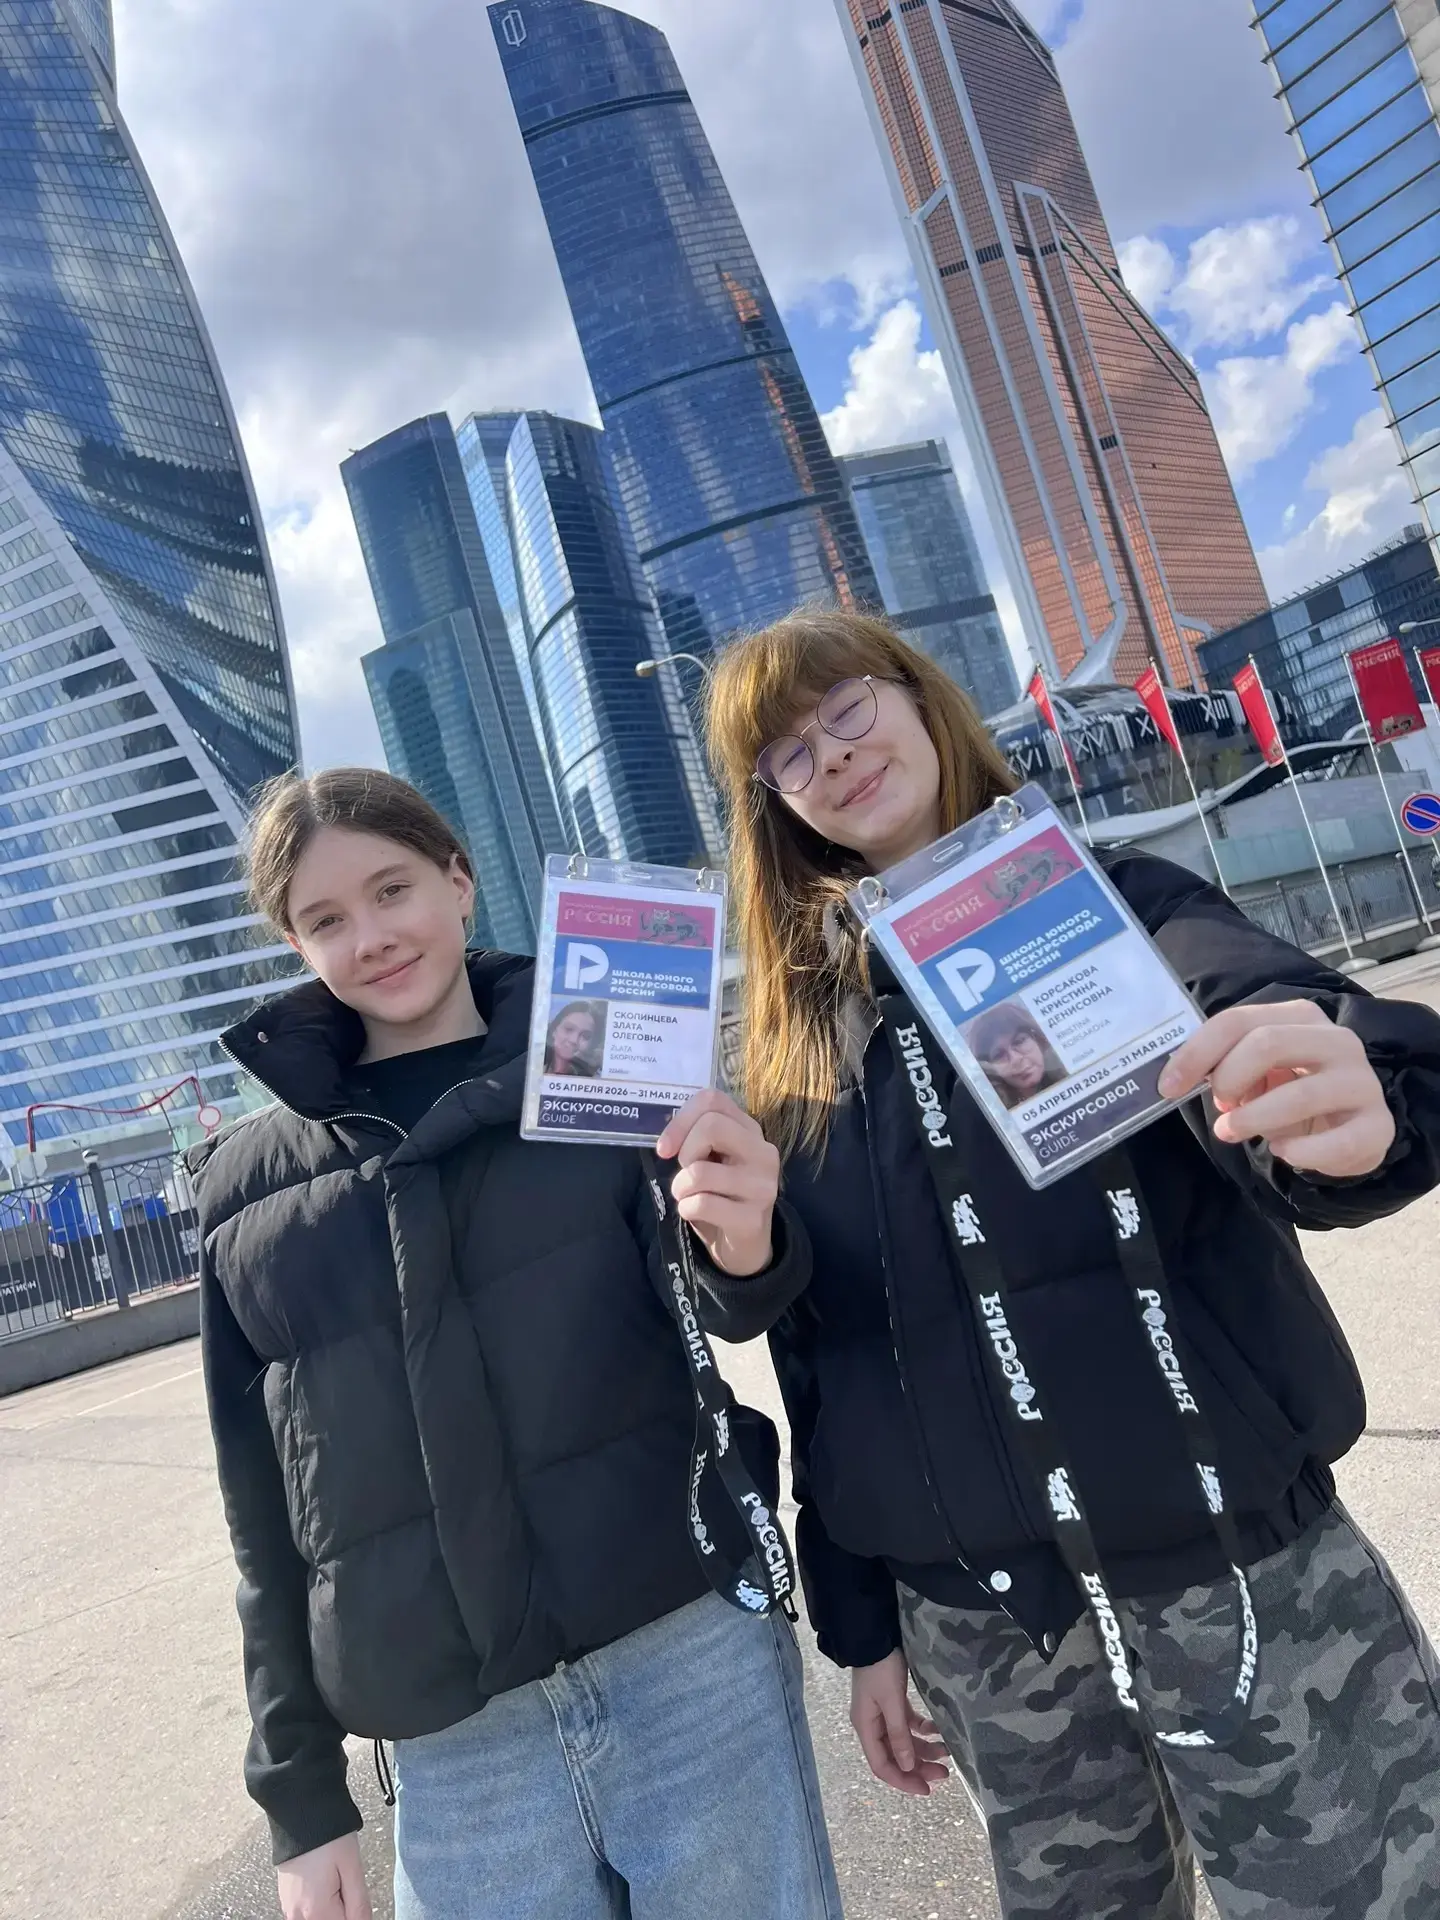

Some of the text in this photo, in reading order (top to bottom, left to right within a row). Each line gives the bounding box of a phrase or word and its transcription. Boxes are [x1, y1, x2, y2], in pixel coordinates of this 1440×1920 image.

[999, 909, 1091, 966] ШКОЛА ЮНОГО
[1004, 915, 1102, 975] ЭКСКУРСОВОДА
[611, 977, 697, 993] ЭКСКУРСОВОДА
[612, 969, 694, 984] ШКОЛА ЮНОГО
[1010, 950, 1062, 983] РОССИИ
[1033, 965, 1099, 1006] КОРСАКОВА
[610, 986, 656, 997] РОССИИ
[1040, 980, 1098, 1017] КРИСТИНА
[1048, 986, 1113, 1029] ДЕНИСОВНА
[612, 1031, 663, 1043] ОЛЕГОВНА
[613, 1022, 643, 1031] ЗЛАТА
[614, 1011, 678, 1024] СКОПИНЦЕВА
[549, 1083, 561, 1091] 05
[563, 1084, 603, 1094] АПРЕЛЯ
[605, 1087, 628, 1096] 2026
[638, 1089, 647, 1097] 31
[649, 1090, 671, 1100] МАЯ
[896, 1022, 954, 1149] РОССИЯ
[1023, 1109, 1038, 1122] 05
[1038, 1084, 1084, 1114] АПРЕЛЯ
[1082, 1067, 1110, 1088] 2026
[1119, 1056, 1131, 1067] 31
[1131, 1042, 1158, 1061] МАЯ
[1159, 1026, 1186, 1046] 2026
[541, 1112, 577, 1124] GUIDE
[543, 1100, 639, 1118] ЭКСКУРСОВОД
[1030, 1078, 1140, 1147] ЭКСКУРСОВОД
[1038, 1131, 1080, 1159] GUIDE
[668, 1261, 712, 1372] РОССИЯ
[979, 1291, 1043, 1421] РОССИЯ
[1137, 1288, 1199, 1414] РОССИЯ
[691, 1449, 717, 1555] РОССИЯ
[740, 1492, 793, 1600] РОССИЯ
[1081, 1572, 1139, 1712] РОССИЯ
